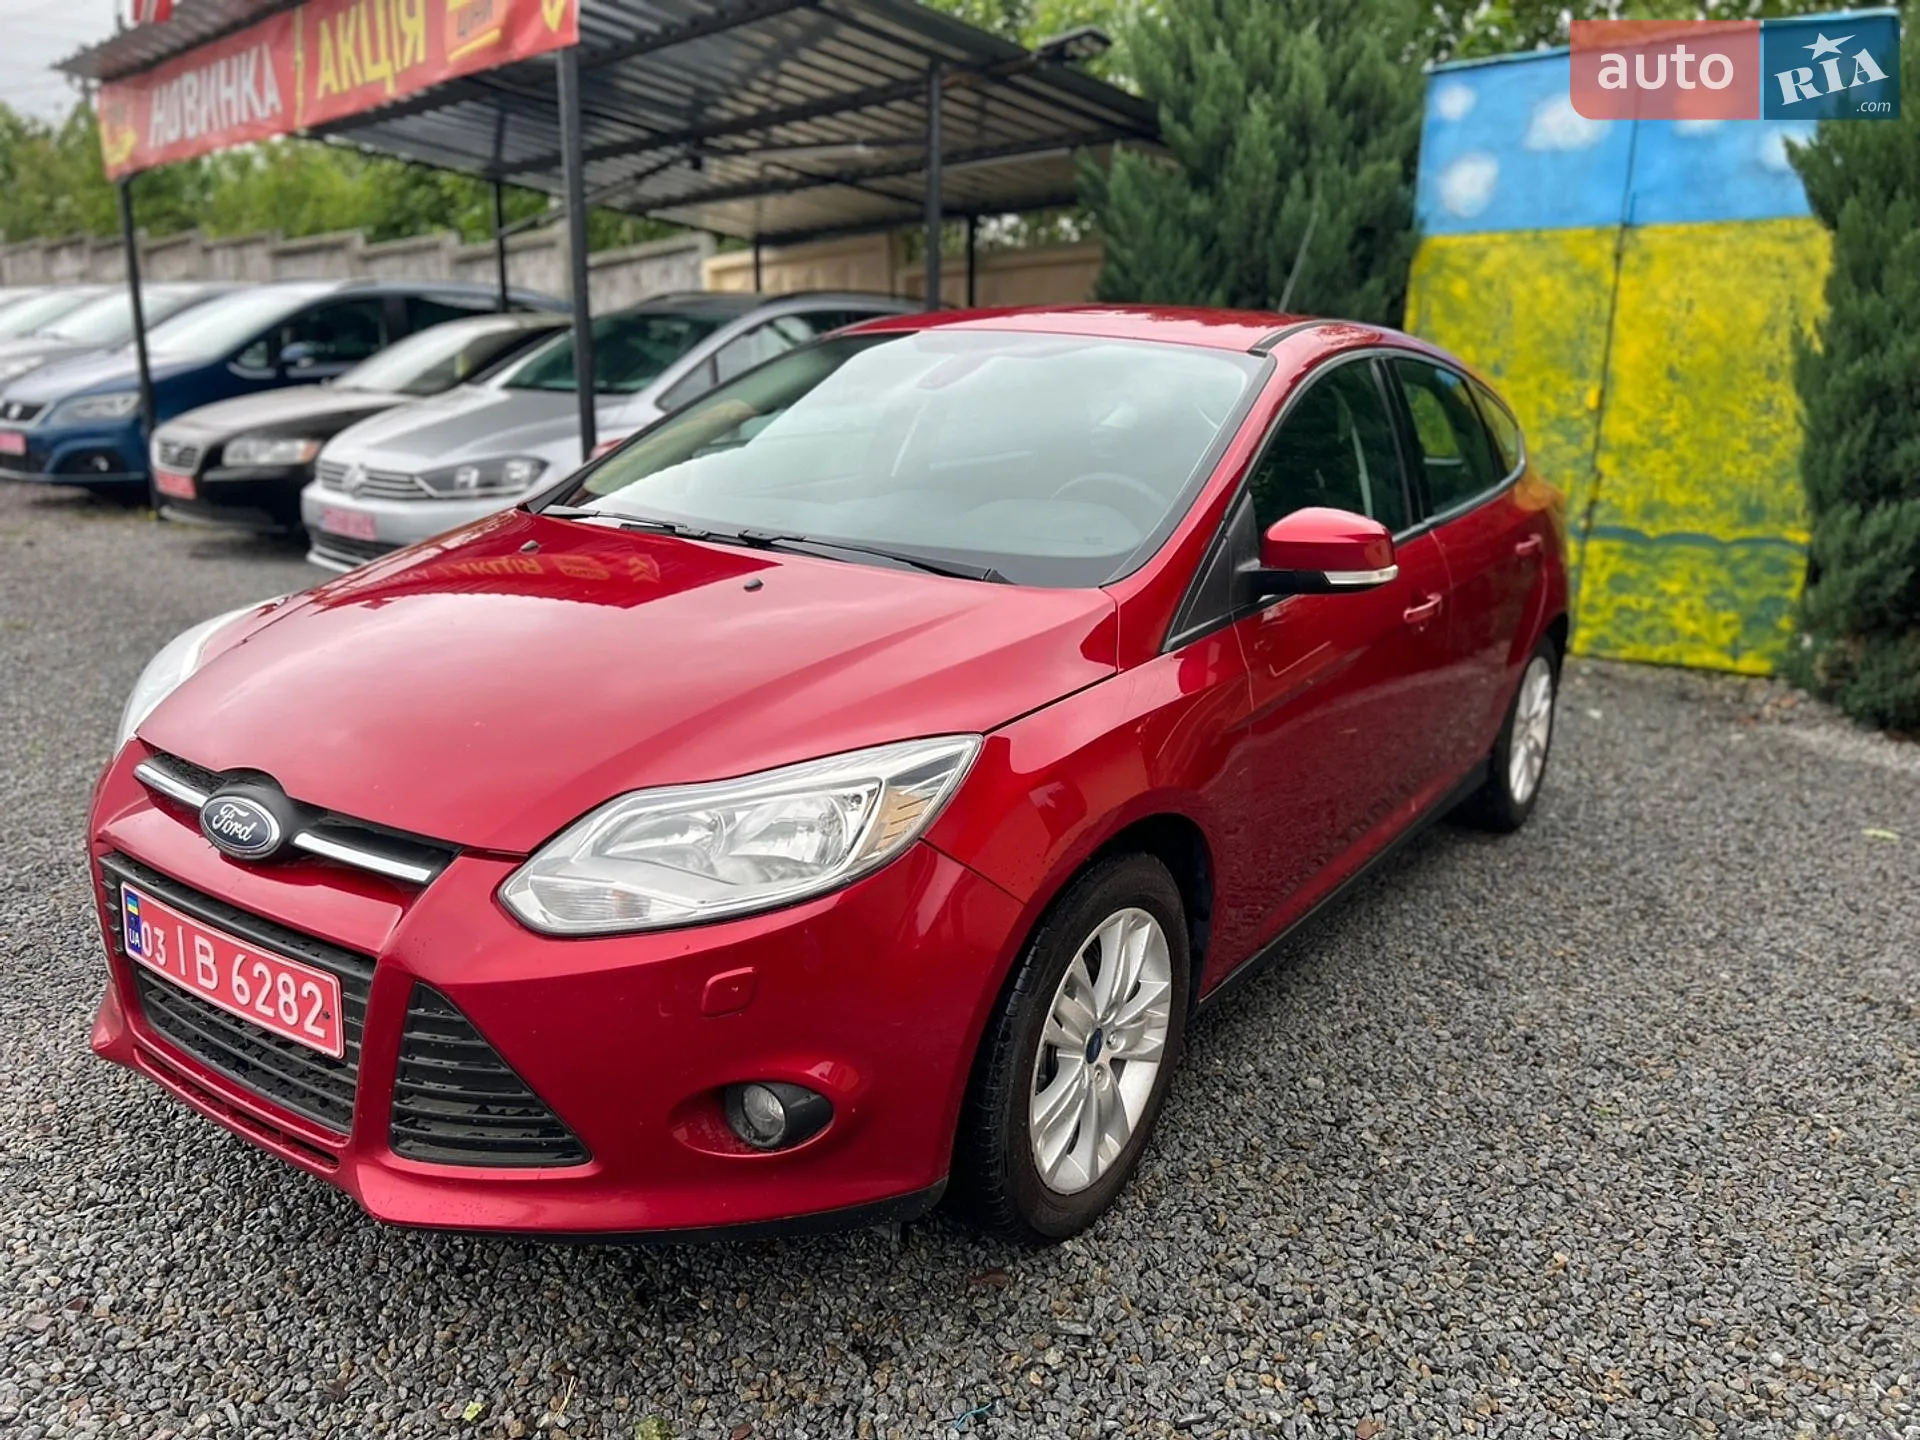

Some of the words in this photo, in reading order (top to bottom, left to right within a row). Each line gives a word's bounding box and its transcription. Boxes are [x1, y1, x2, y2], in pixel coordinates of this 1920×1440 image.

[149, 45, 283, 148] НОВИНКА
[316, 0, 427, 99] АКЦІЯ
[212, 803, 258, 842] Ford
[128, 928, 141, 947] UA
[141, 921, 167, 966] 03
[231, 954, 326, 1038] 6282
